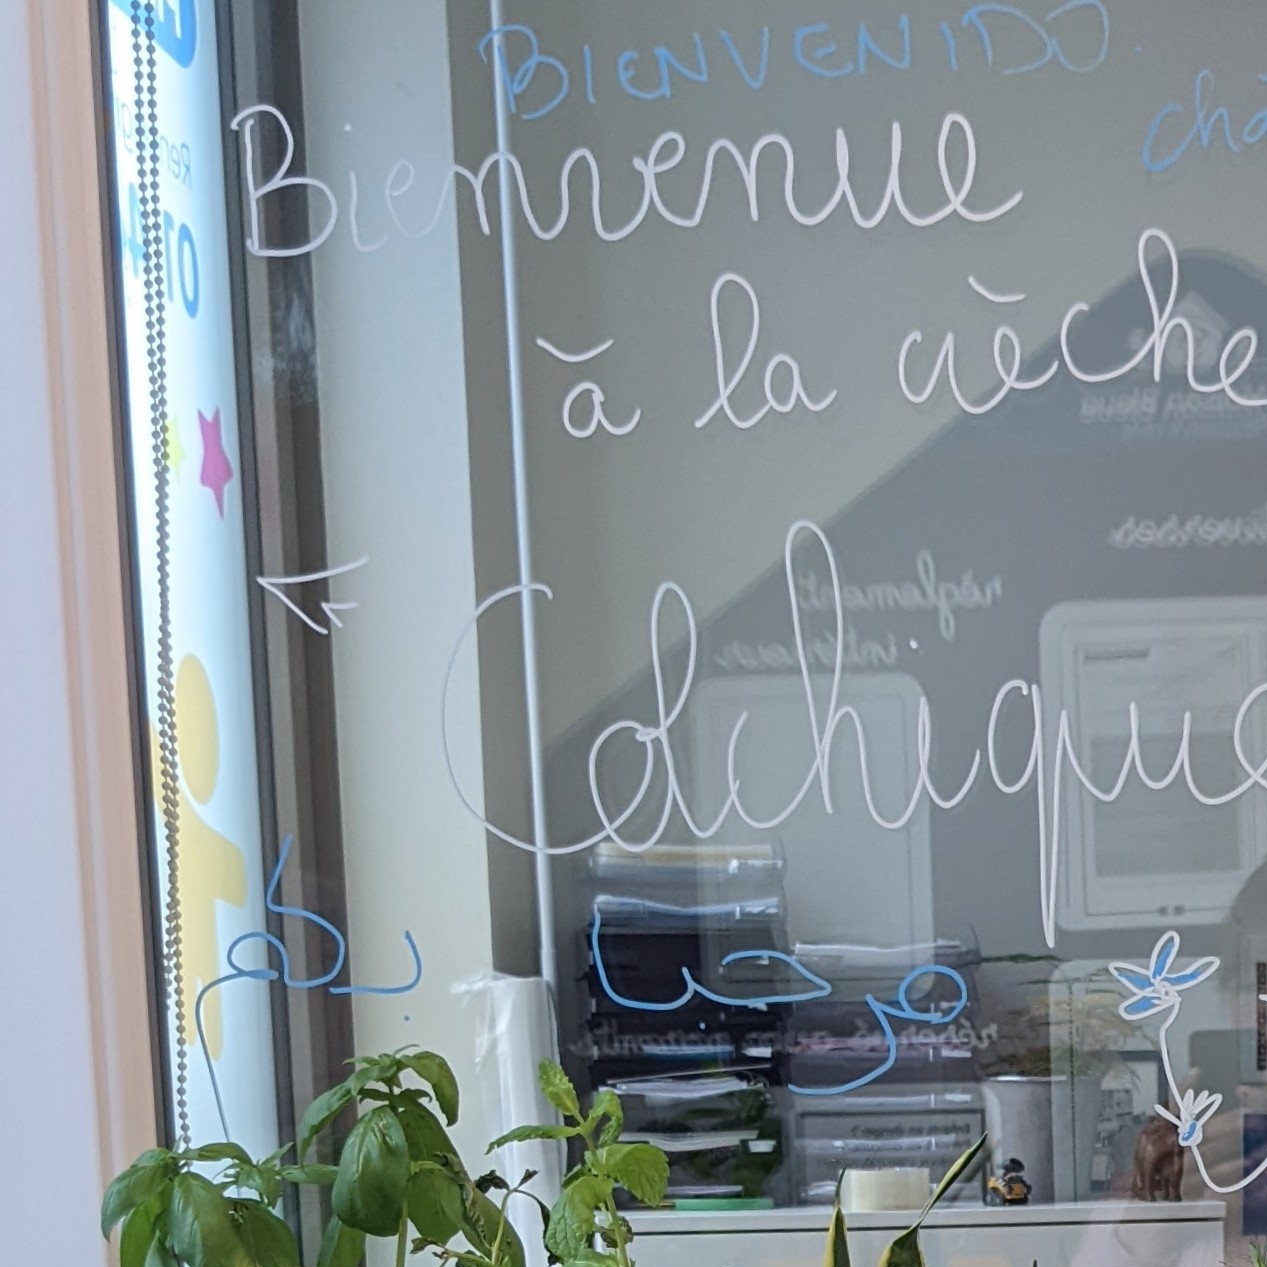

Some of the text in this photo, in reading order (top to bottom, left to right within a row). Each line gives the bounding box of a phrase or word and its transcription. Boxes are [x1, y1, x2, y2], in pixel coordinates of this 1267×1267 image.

[478, 0, 1109, 119] BIENVENIDO
[231, 104, 1023, 258] Bienvenue
[695, 272, 838, 429] la
